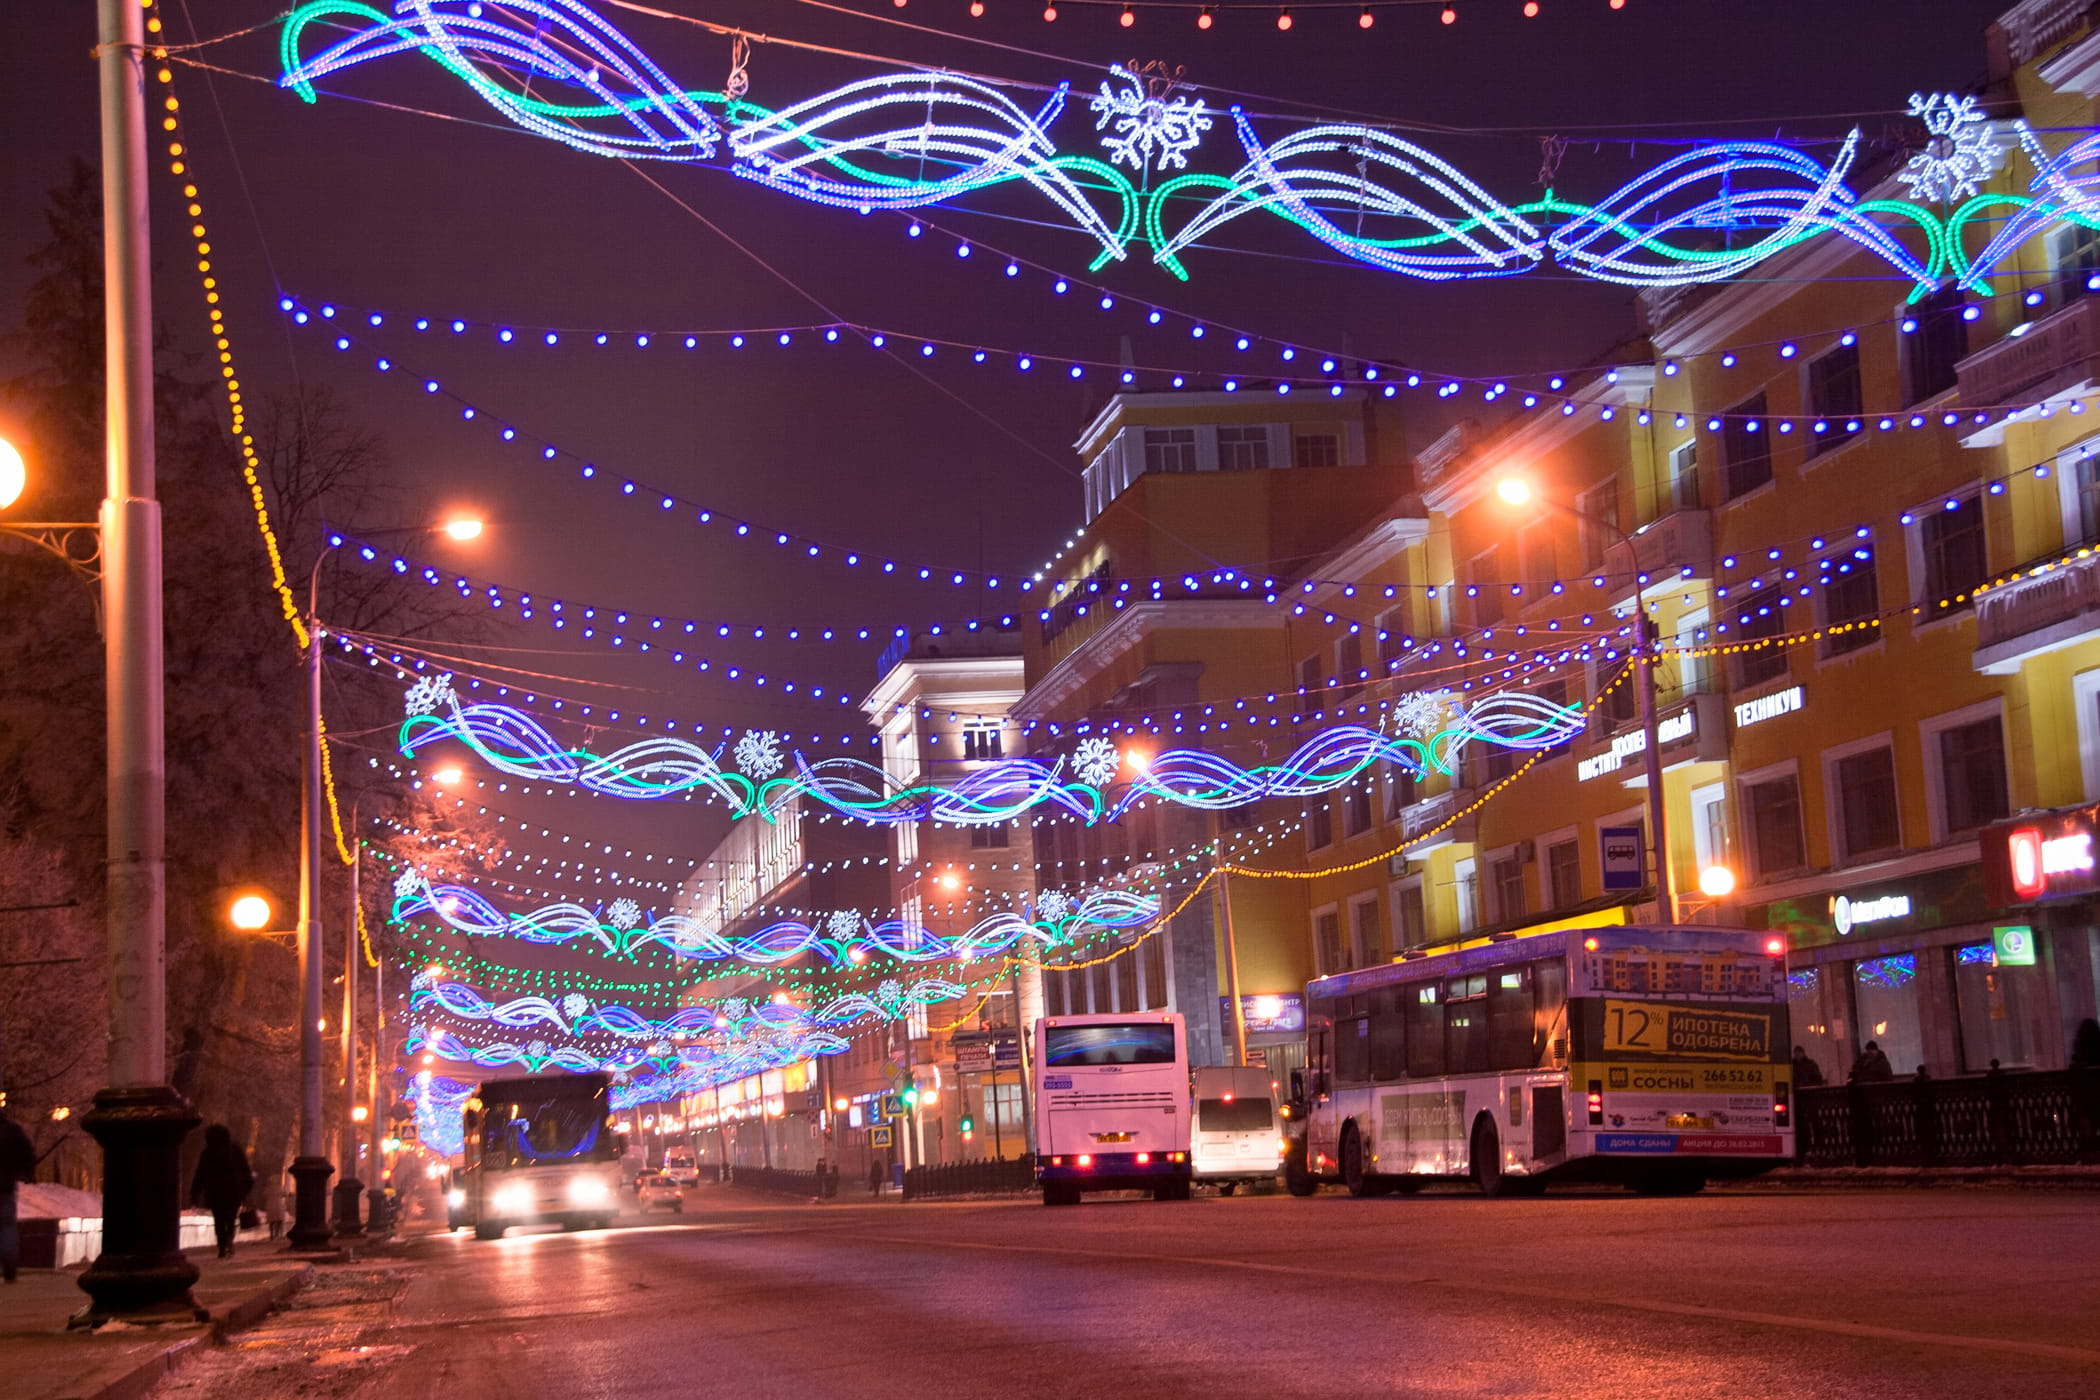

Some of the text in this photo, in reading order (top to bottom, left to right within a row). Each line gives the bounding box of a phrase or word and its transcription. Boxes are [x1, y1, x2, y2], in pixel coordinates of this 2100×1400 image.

[1734, 685, 1803, 728] ТЕХНИКУМ
[1672, 1016, 1751, 1037] ИПОТЕКА
[1671, 1032, 1762, 1051] ОДОБРЕНА
[1633, 1076, 1695, 1089] СОСНЫ
[1703, 1069, 1763, 1083] 266 52 62
[1610, 1138, 1637, 1148] ДОМА
[1638, 1139, 1672, 1148] СДАНЫ
[1682, 1140, 1711, 1150] АКЦИЯ
[1712, 1140, 1727, 1149] ДО
